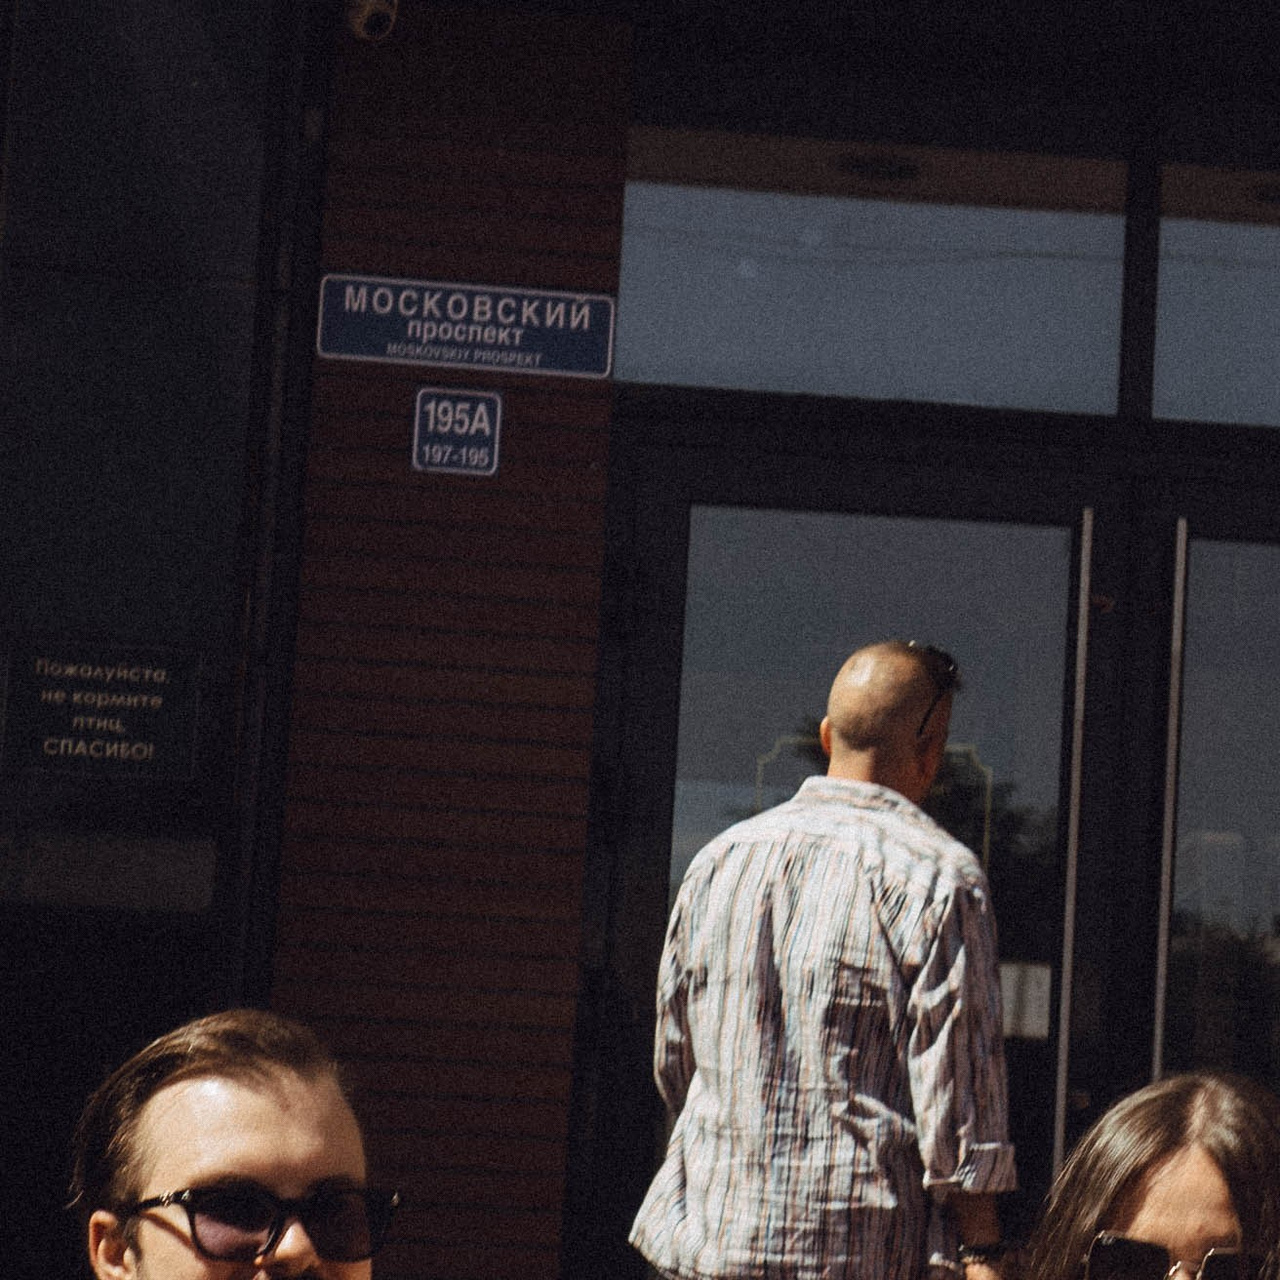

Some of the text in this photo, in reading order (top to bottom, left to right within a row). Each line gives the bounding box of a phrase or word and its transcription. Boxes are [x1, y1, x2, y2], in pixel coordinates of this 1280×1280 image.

[344, 284, 592, 330] МОСКОВСКИЙ
[407, 320, 524, 346] проспект
[472, 349, 543, 367] PROSPEKT
[423, 400, 491, 437] 195А
[40, 689, 164, 709] не кормите
[43, 736, 155, 761] СПАСИБО!
